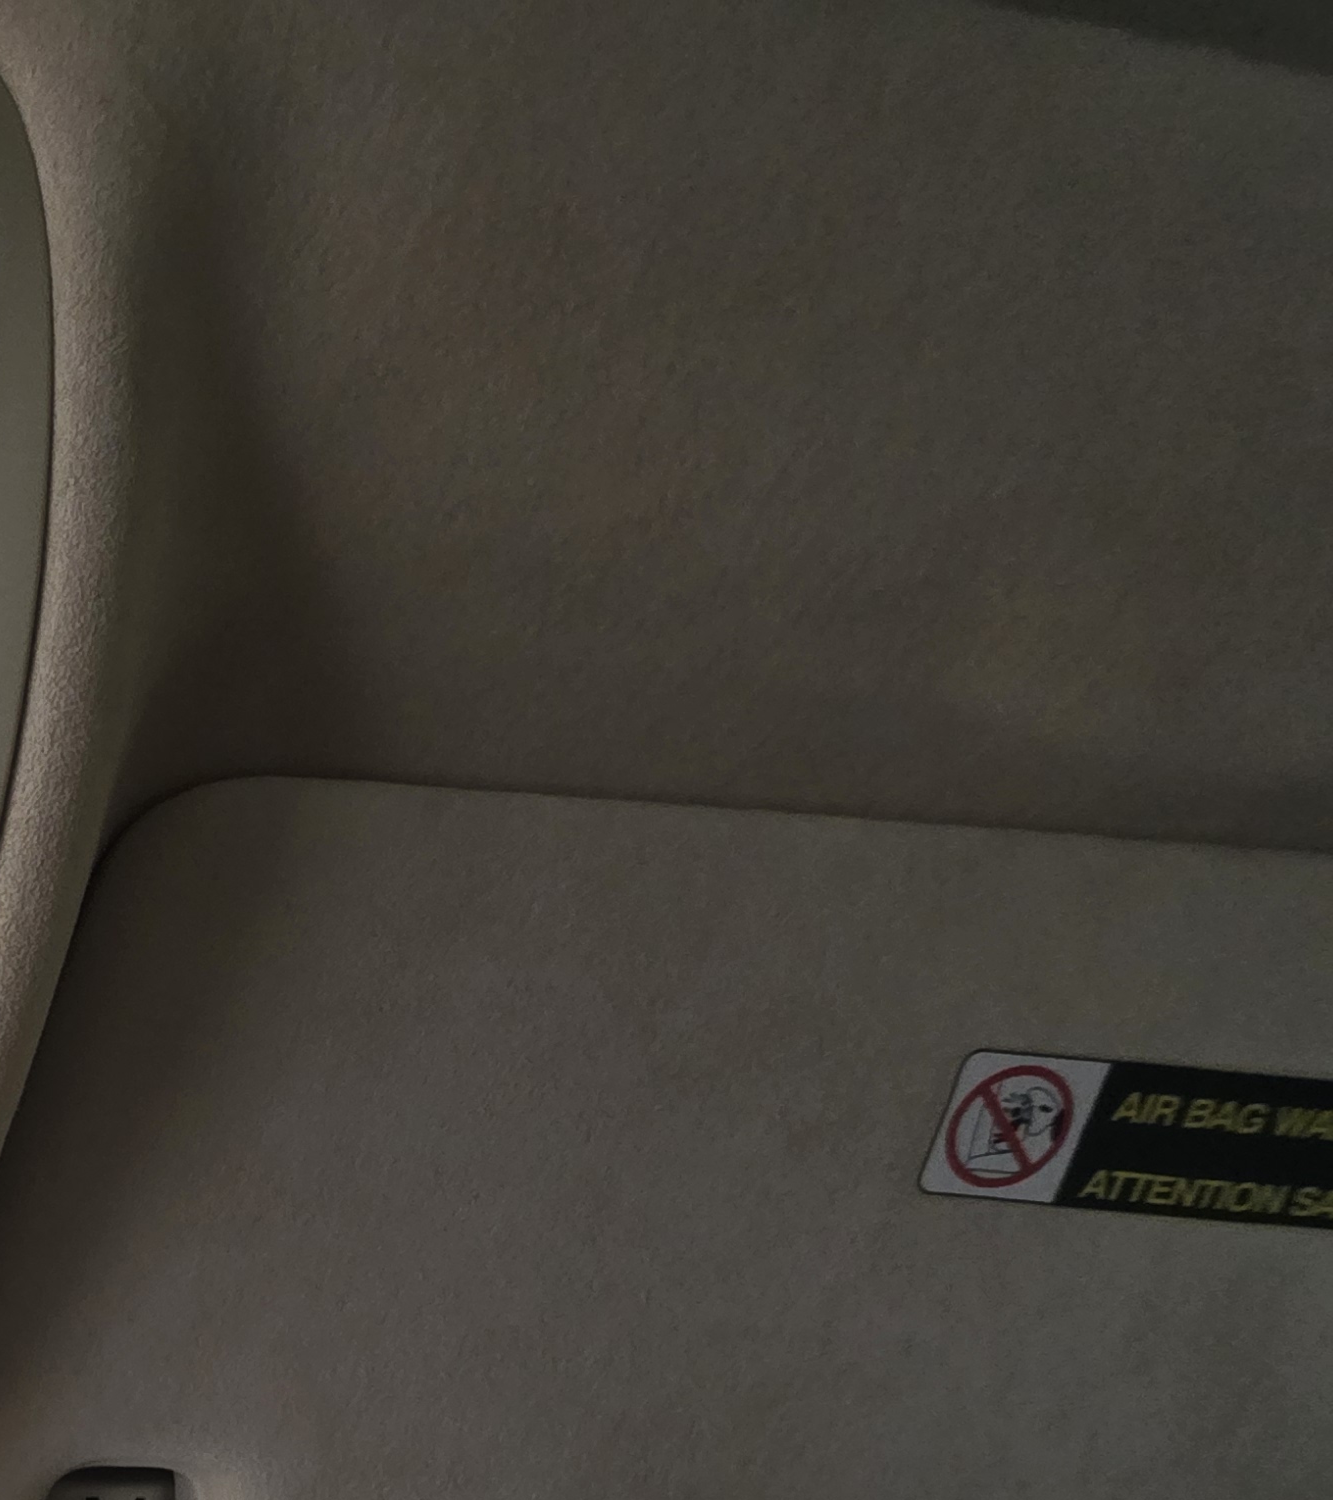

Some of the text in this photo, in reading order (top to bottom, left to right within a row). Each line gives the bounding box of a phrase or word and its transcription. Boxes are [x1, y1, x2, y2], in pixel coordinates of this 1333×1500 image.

[1112, 1092, 1181, 1126] AIR
[1183, 1099, 1270, 1134] BAG
[1078, 1170, 1288, 1214] ATTENTION
